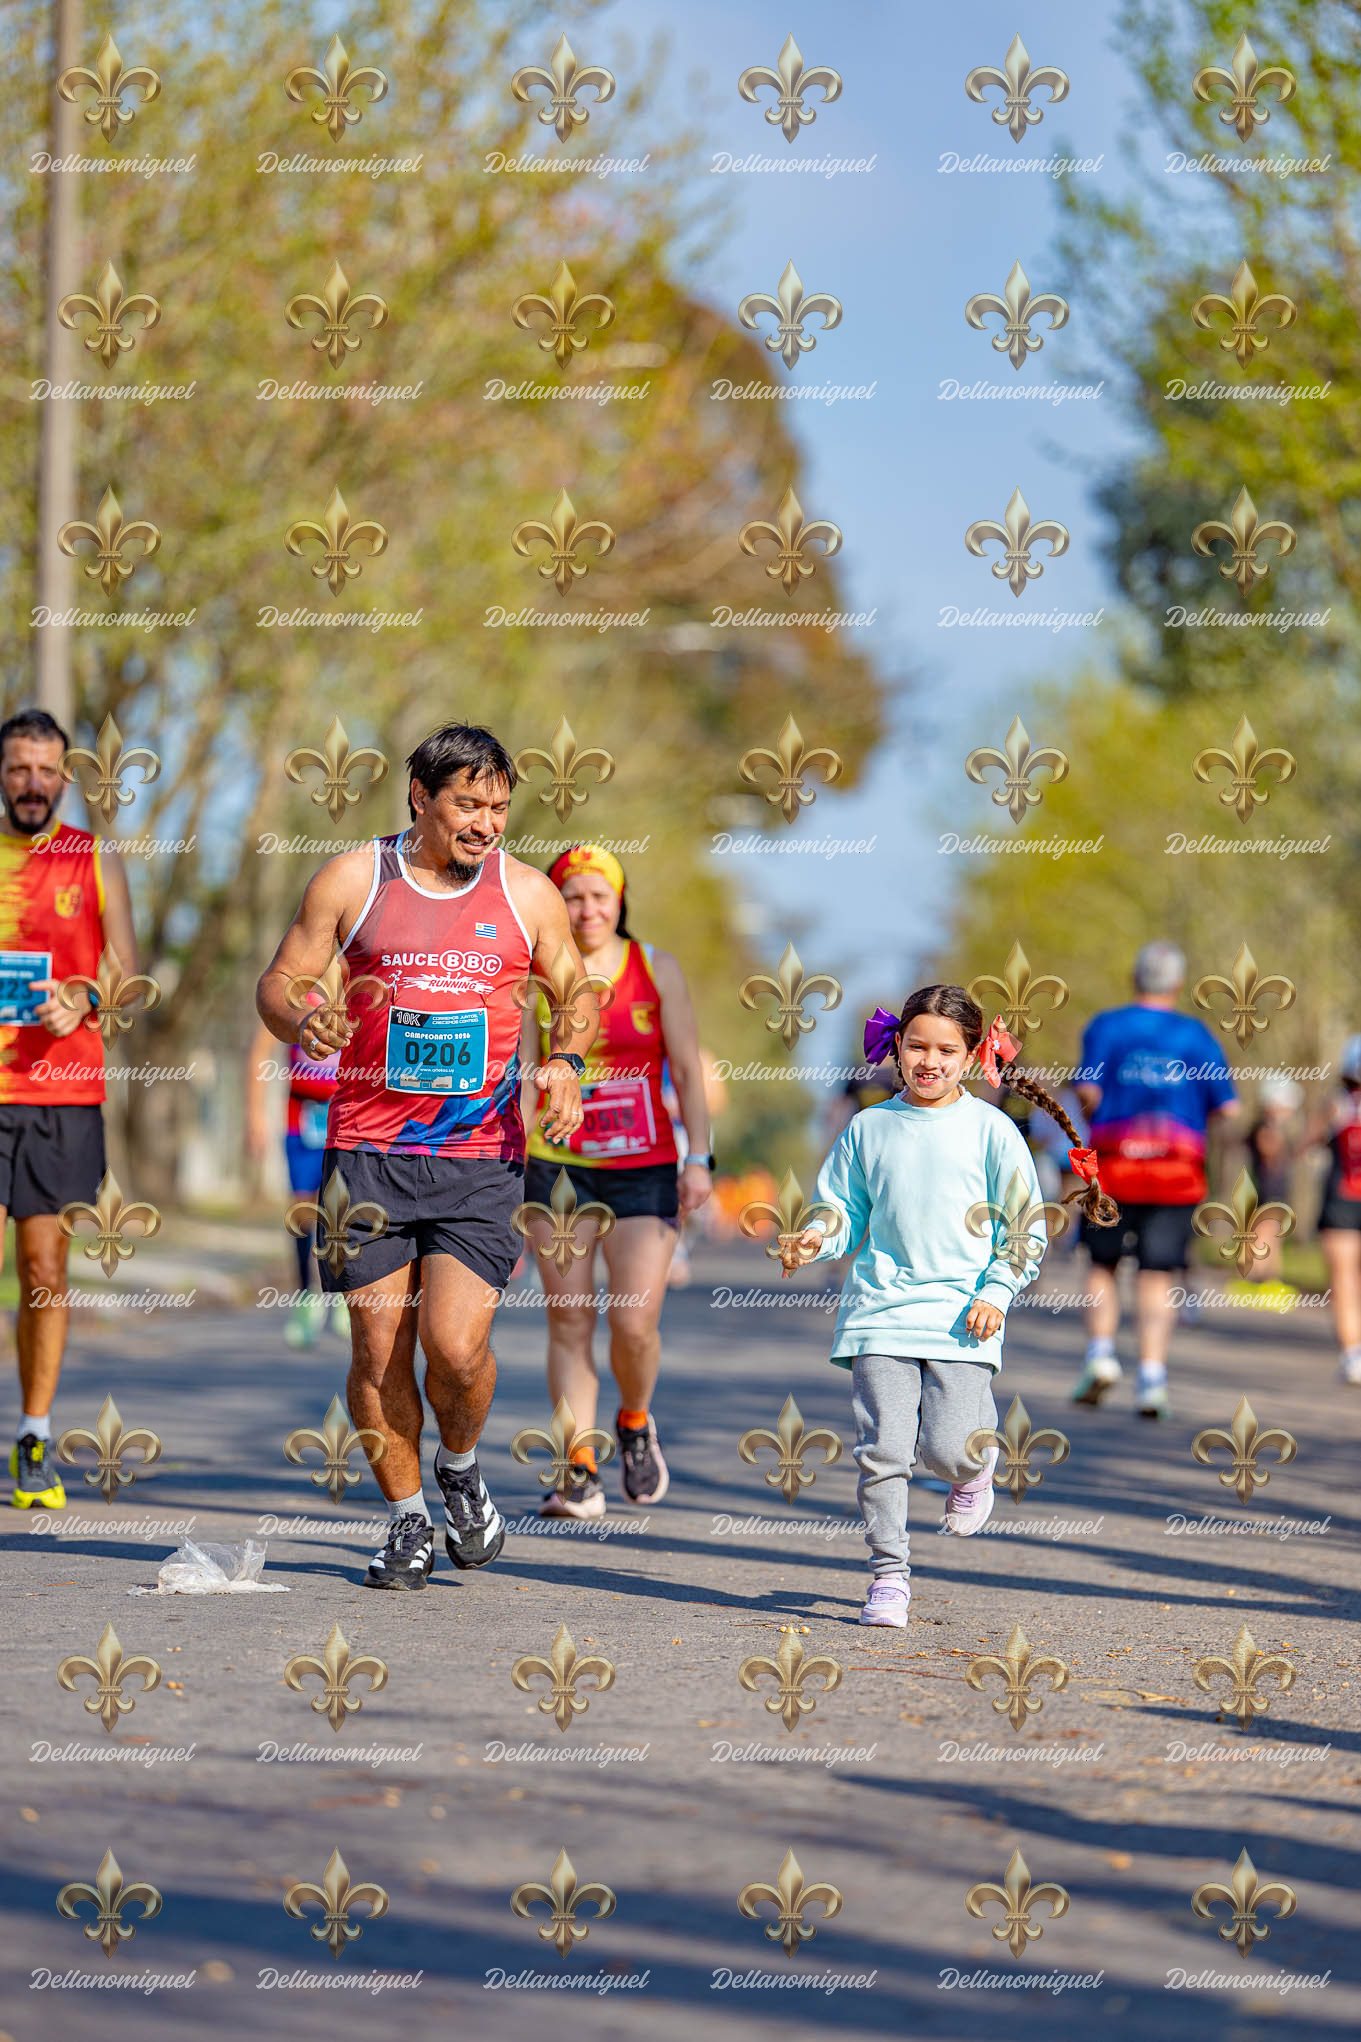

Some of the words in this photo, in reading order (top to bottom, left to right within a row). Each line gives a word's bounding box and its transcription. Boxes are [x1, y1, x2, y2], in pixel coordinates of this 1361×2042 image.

[381, 953, 439, 967] SAUCE
[445, 953, 499, 973] BBC
[428, 979, 477, 990] RUNNING
[396, 1011, 421, 1026] 10K
[404, 1031, 453, 1040] CAMPEONATO
[454, 1032, 471, 1040] 2026
[405, 1041, 471, 1066] 0206
